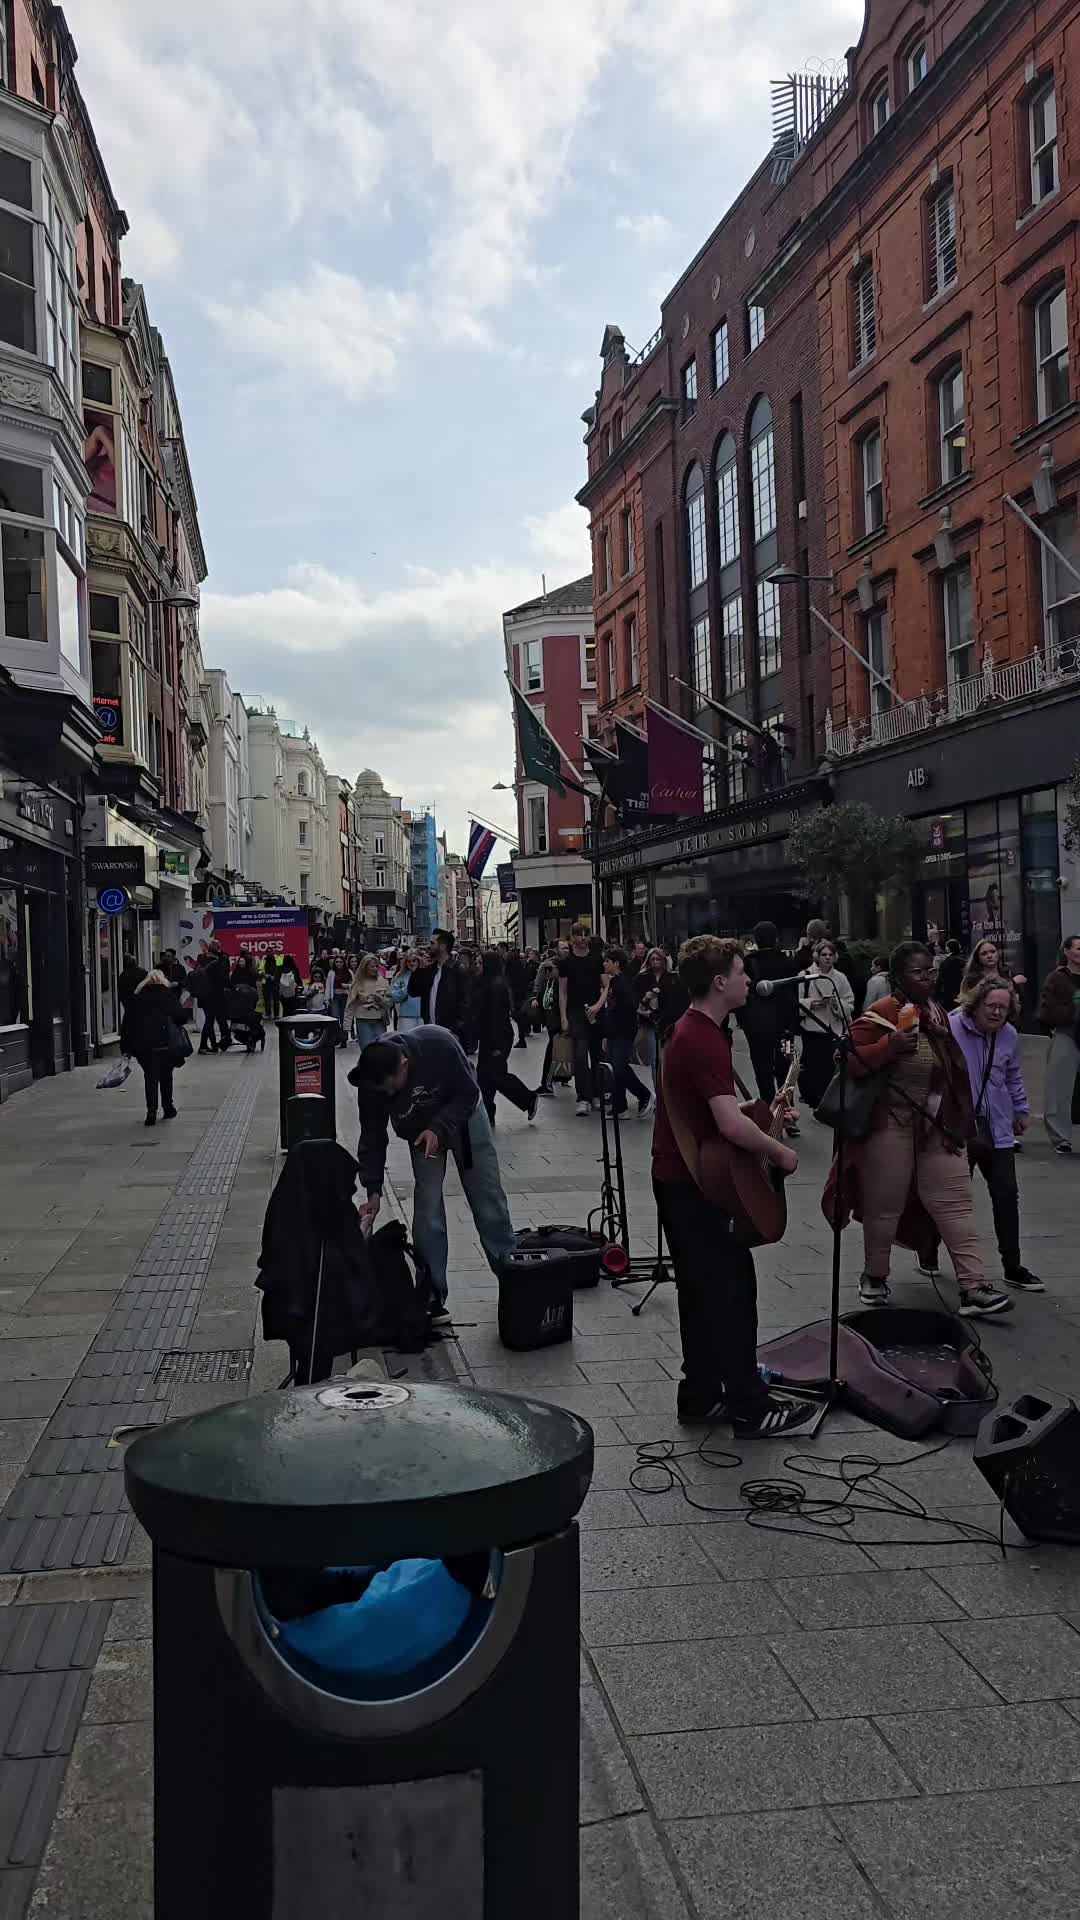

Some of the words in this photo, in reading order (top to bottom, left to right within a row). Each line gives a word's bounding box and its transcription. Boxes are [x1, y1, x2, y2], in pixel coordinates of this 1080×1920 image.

[907, 767, 925, 789] AIB
[675, 832, 710, 854] WEIR
[728, 817, 768, 842] SONS
[92, 861, 138, 872] SWAROVSKI
[240, 940, 284, 952] SHOES
